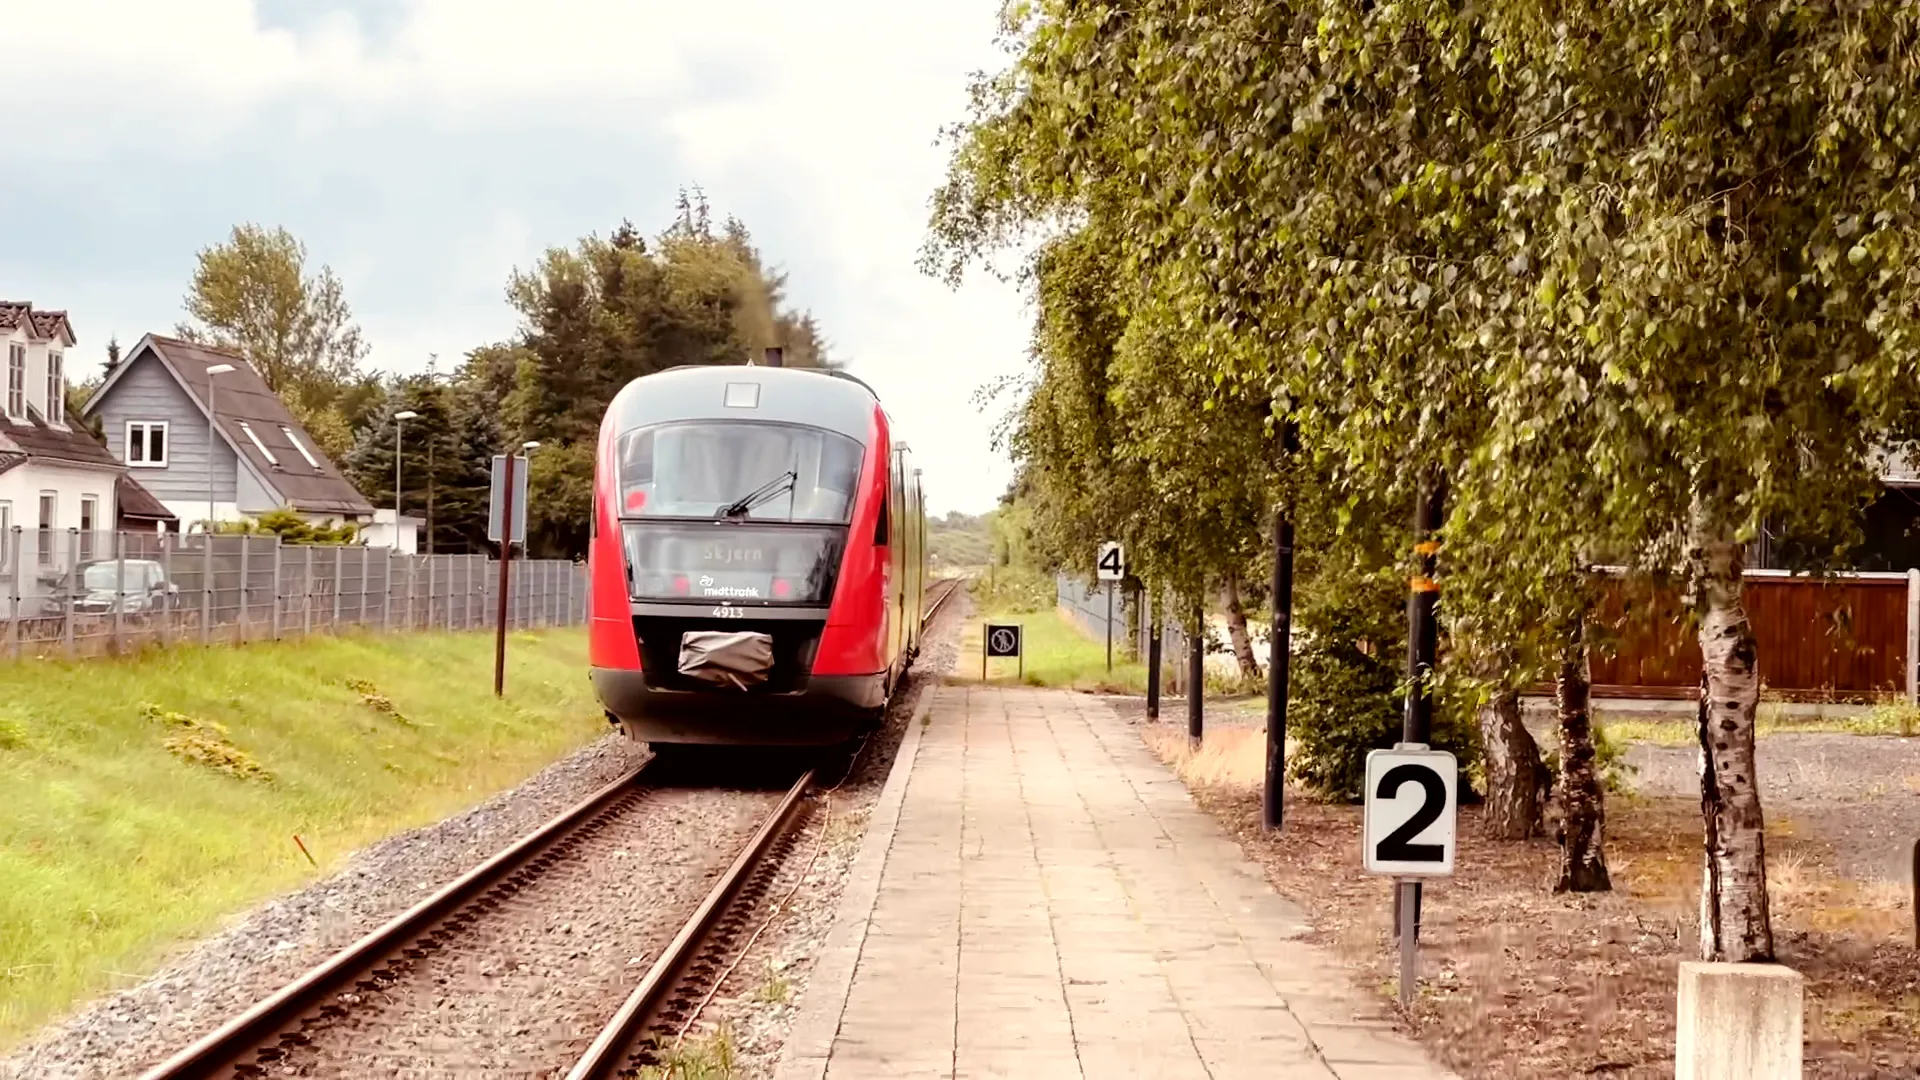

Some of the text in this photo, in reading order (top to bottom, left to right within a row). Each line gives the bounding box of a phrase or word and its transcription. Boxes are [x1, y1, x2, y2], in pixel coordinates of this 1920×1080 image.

[704, 543, 762, 563] Skjern
[1099, 547, 1122, 575] 4
[704, 586, 760, 598] midttrafik
[713, 607, 744, 618] 4913
[1376, 764, 1447, 862] 2
